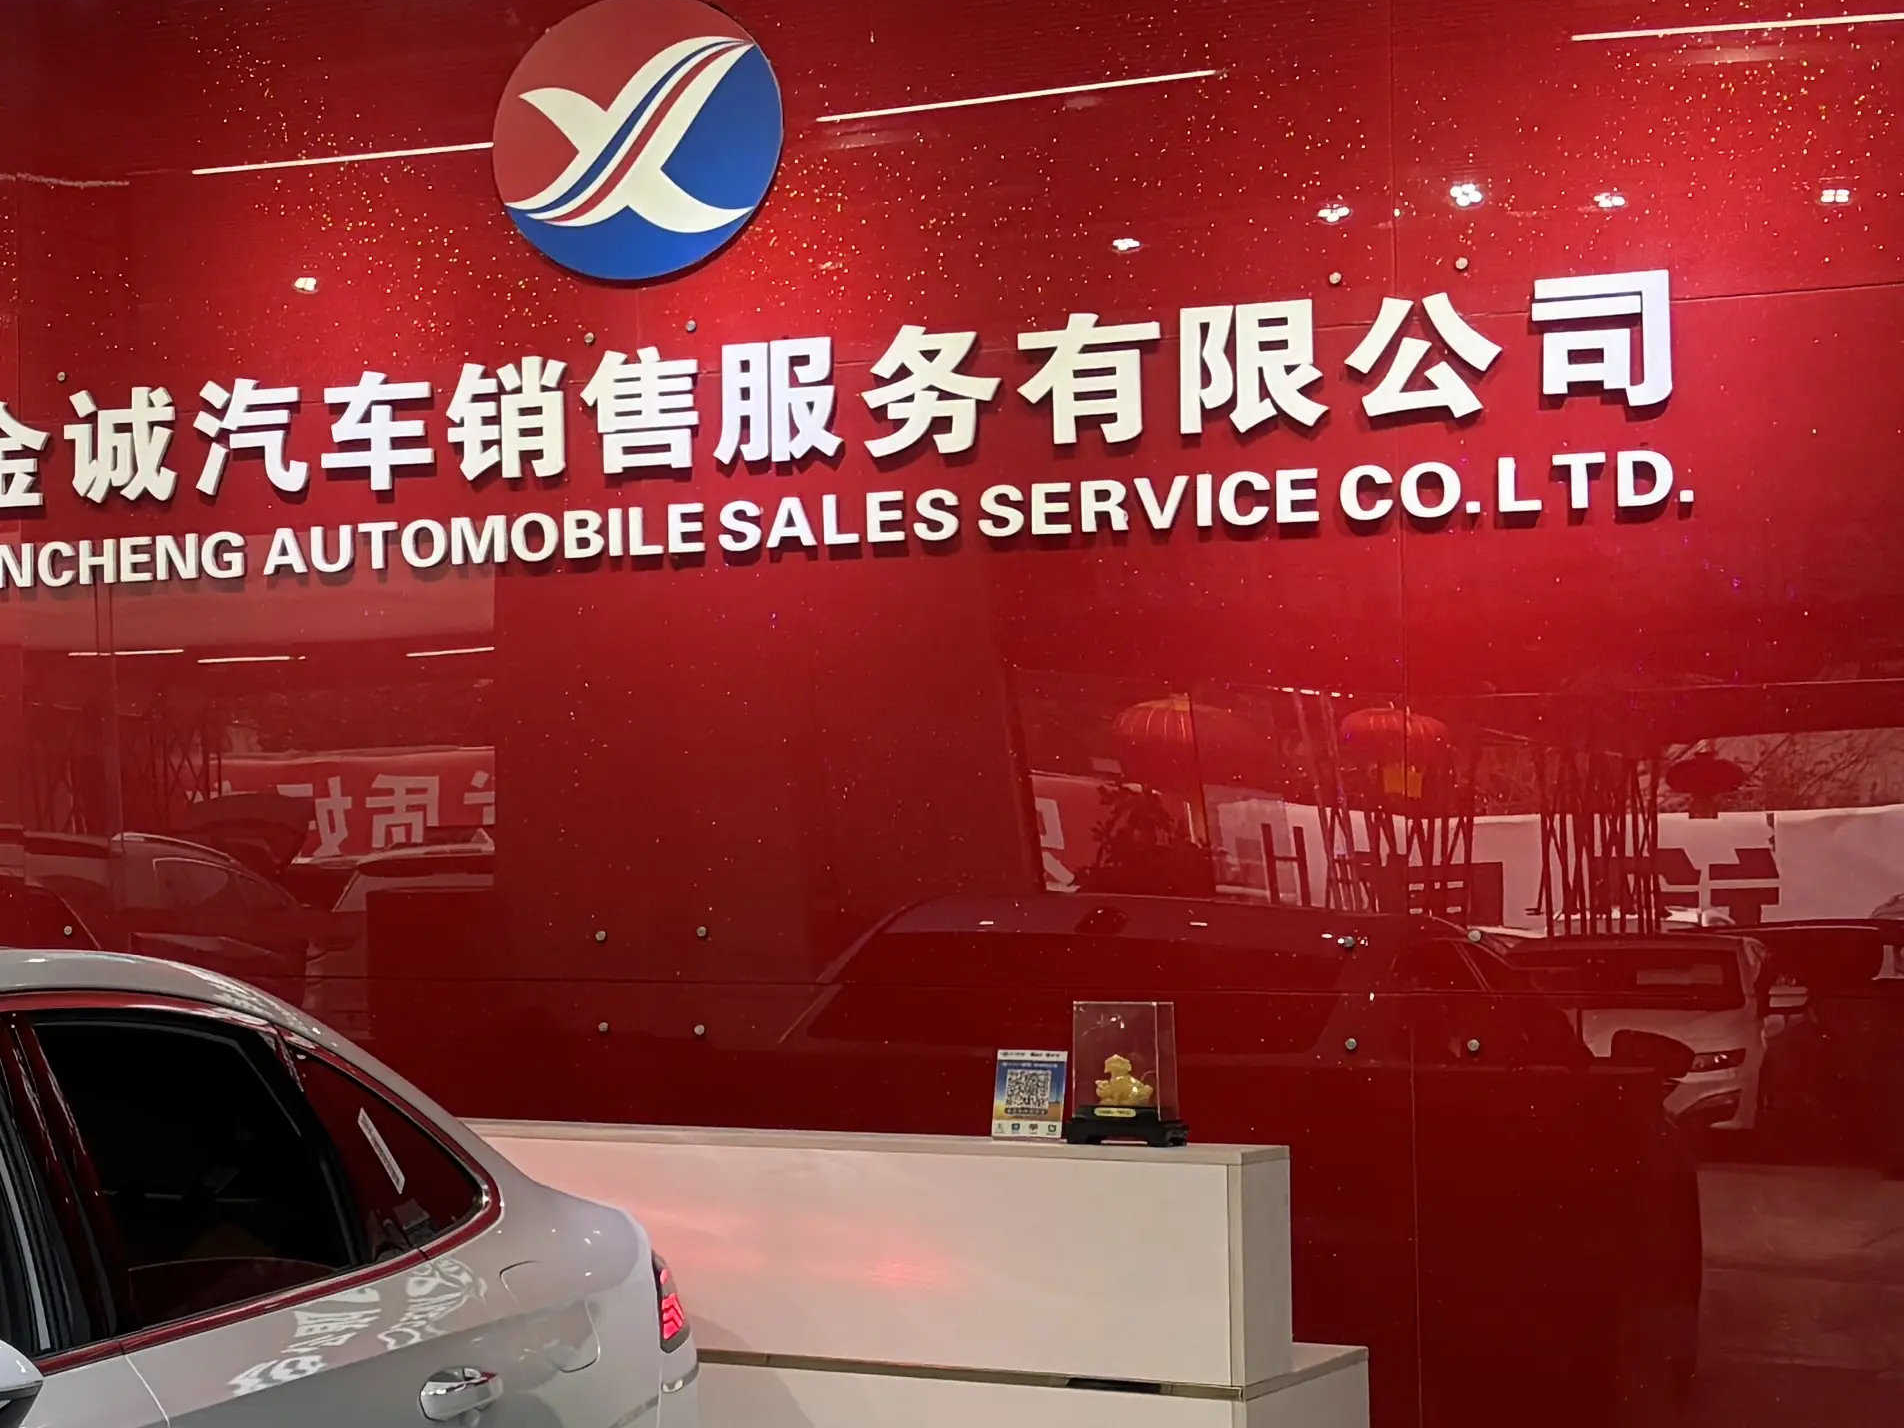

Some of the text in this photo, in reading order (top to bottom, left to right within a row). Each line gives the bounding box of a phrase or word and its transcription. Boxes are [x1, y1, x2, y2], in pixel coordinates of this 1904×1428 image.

[262, 502, 707, 575] AUTOMOBILE
[716, 486, 963, 552] SALES
[977, 468, 1321, 539] SERVICE
